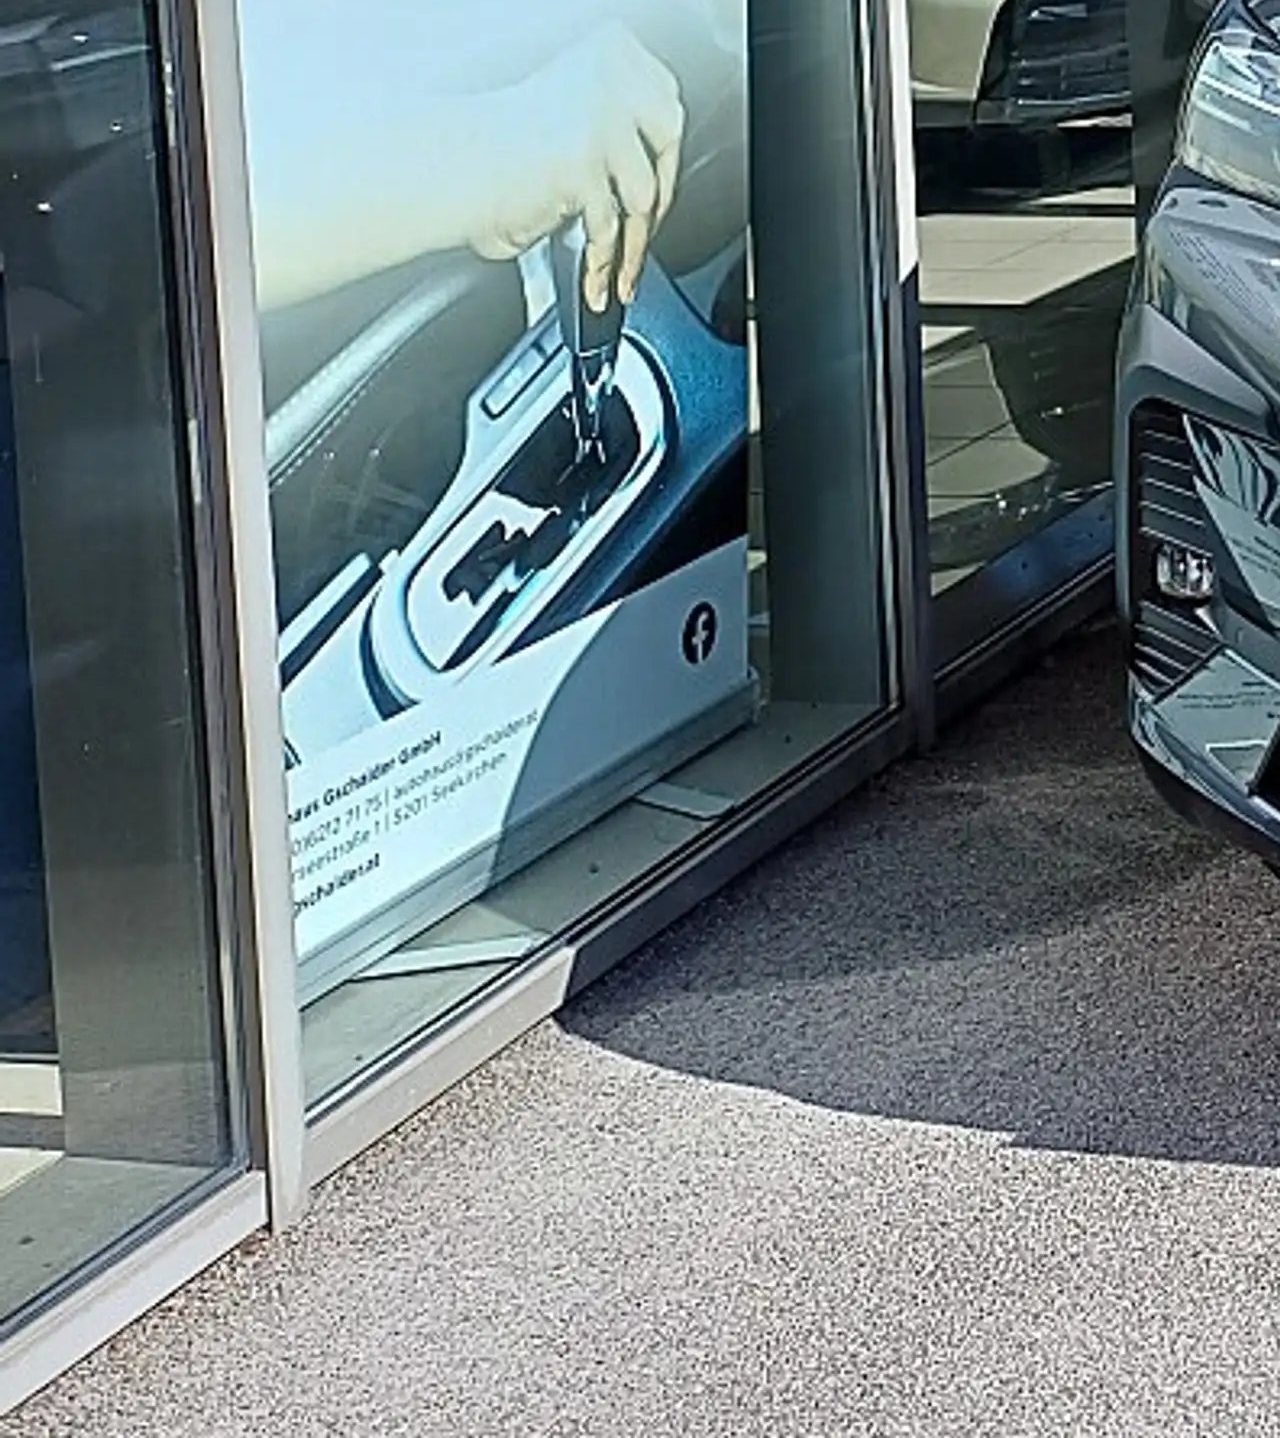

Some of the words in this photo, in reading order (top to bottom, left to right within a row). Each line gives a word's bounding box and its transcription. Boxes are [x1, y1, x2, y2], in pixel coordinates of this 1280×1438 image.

[322, 757, 397, 806] Gschaider
[398, 730, 442, 765] GmbH
[394, 794, 430, 827] 5201
